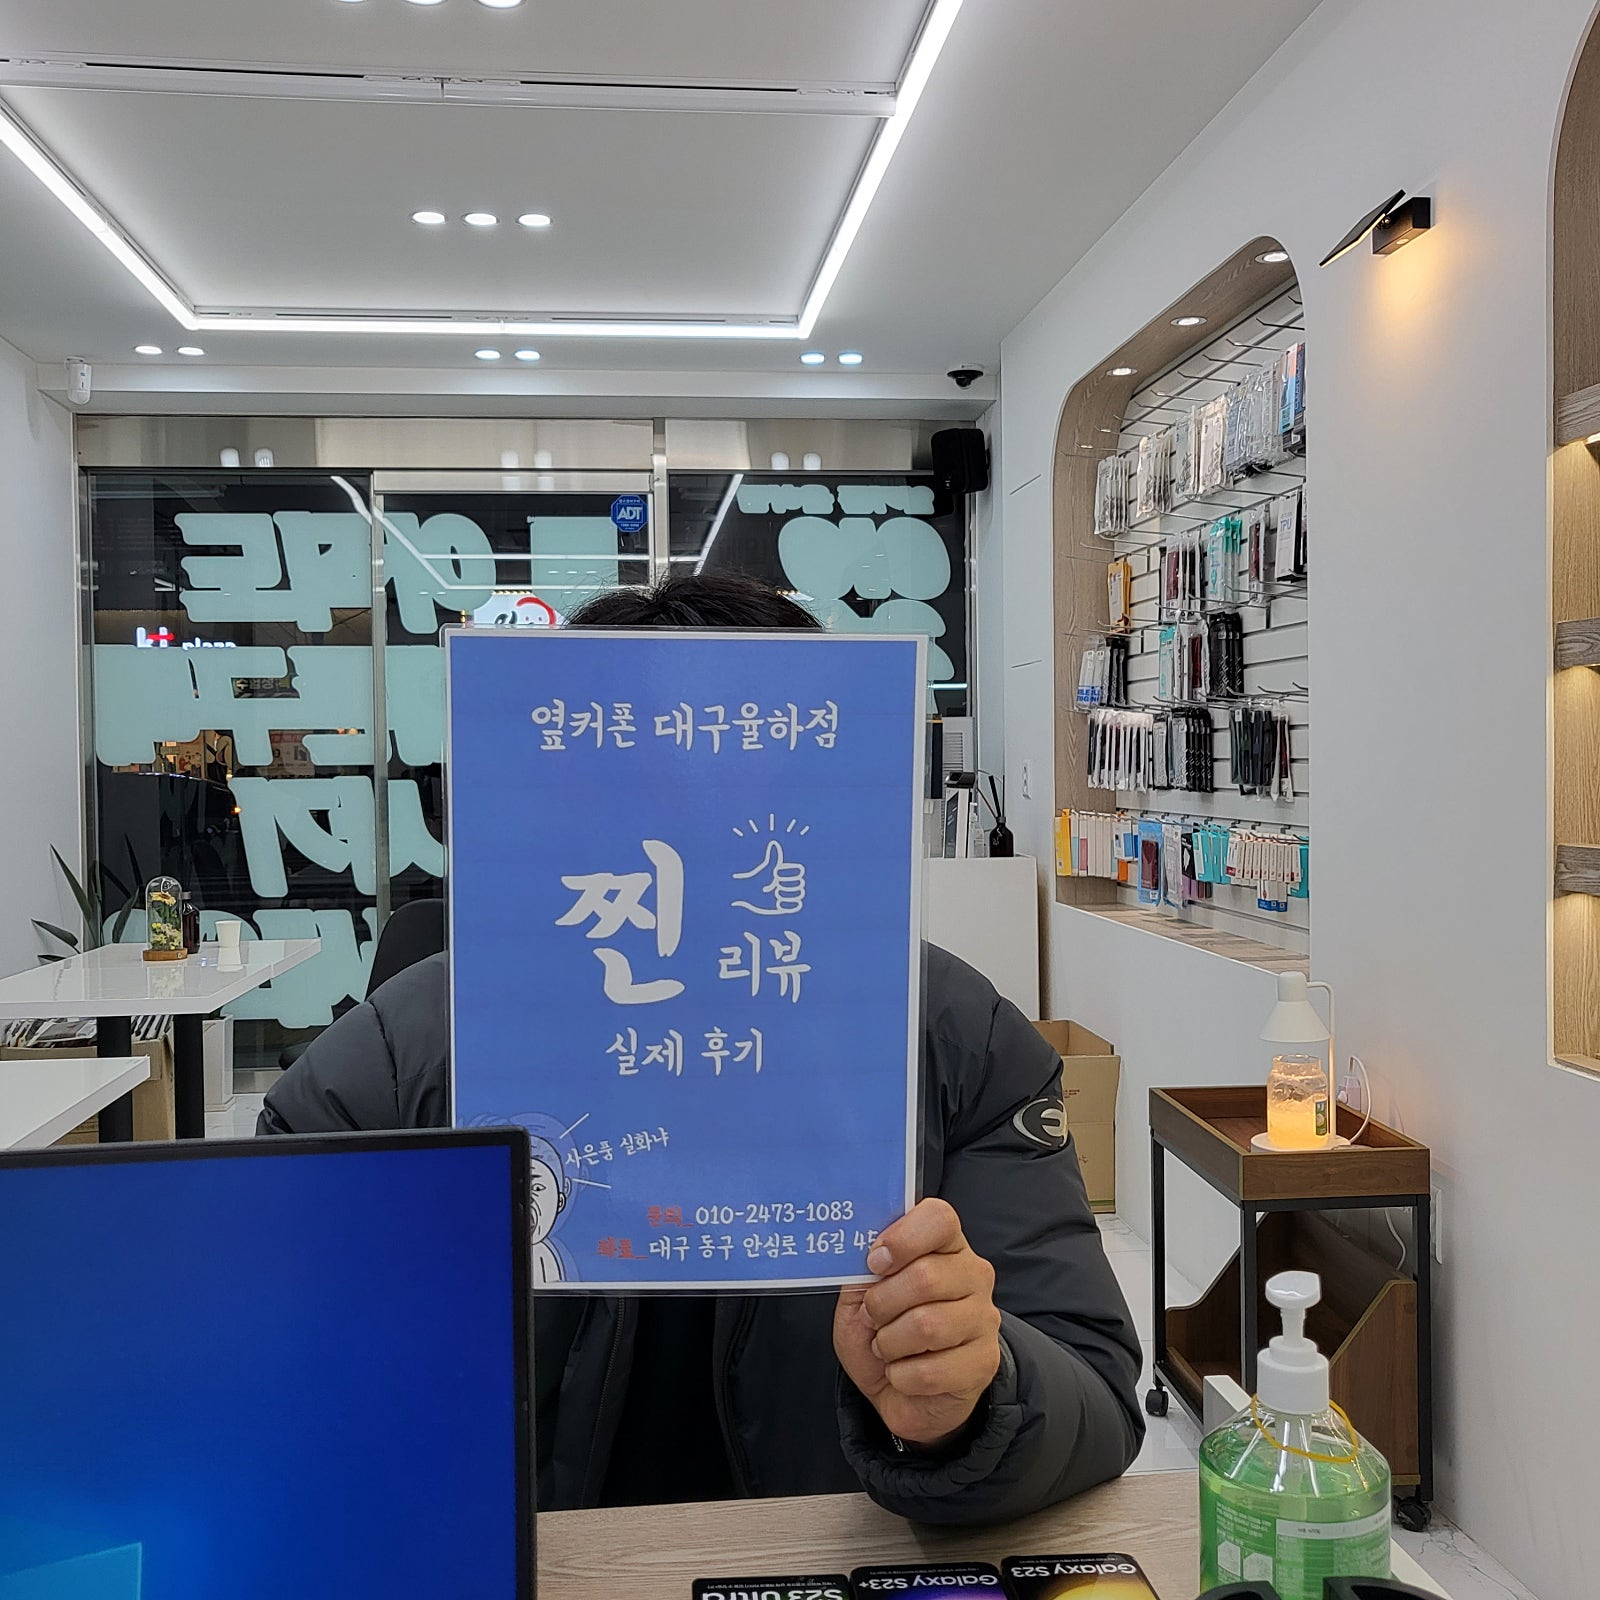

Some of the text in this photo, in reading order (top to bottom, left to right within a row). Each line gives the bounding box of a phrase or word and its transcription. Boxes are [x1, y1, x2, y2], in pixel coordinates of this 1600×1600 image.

[616, 506, 644, 520] ADT
[136, 627, 175, 648] kt
[531, 699, 840, 754] 옆커폰 대구율하점
[554, 839, 686, 1005] 찐
[718, 930, 812, 1004] 리뷰
[605, 1025, 765, 1077] 실제 후기
[619, 1126, 670, 1156] 실화냐
[695, 1200, 855, 1225] 010-2473-1083
[648, 1235, 690, 1262] 대구
[698, 1233, 735, 1261] 동구
[742, 1233, 799, 1259] 안심로
[805, 1228, 846, 1255] 16길
[858, 1573, 999, 1590] Galaxy S23+
[1010, 1563, 1138, 1578] Galaxy S23
[787, 1588, 844, 1600] S23
